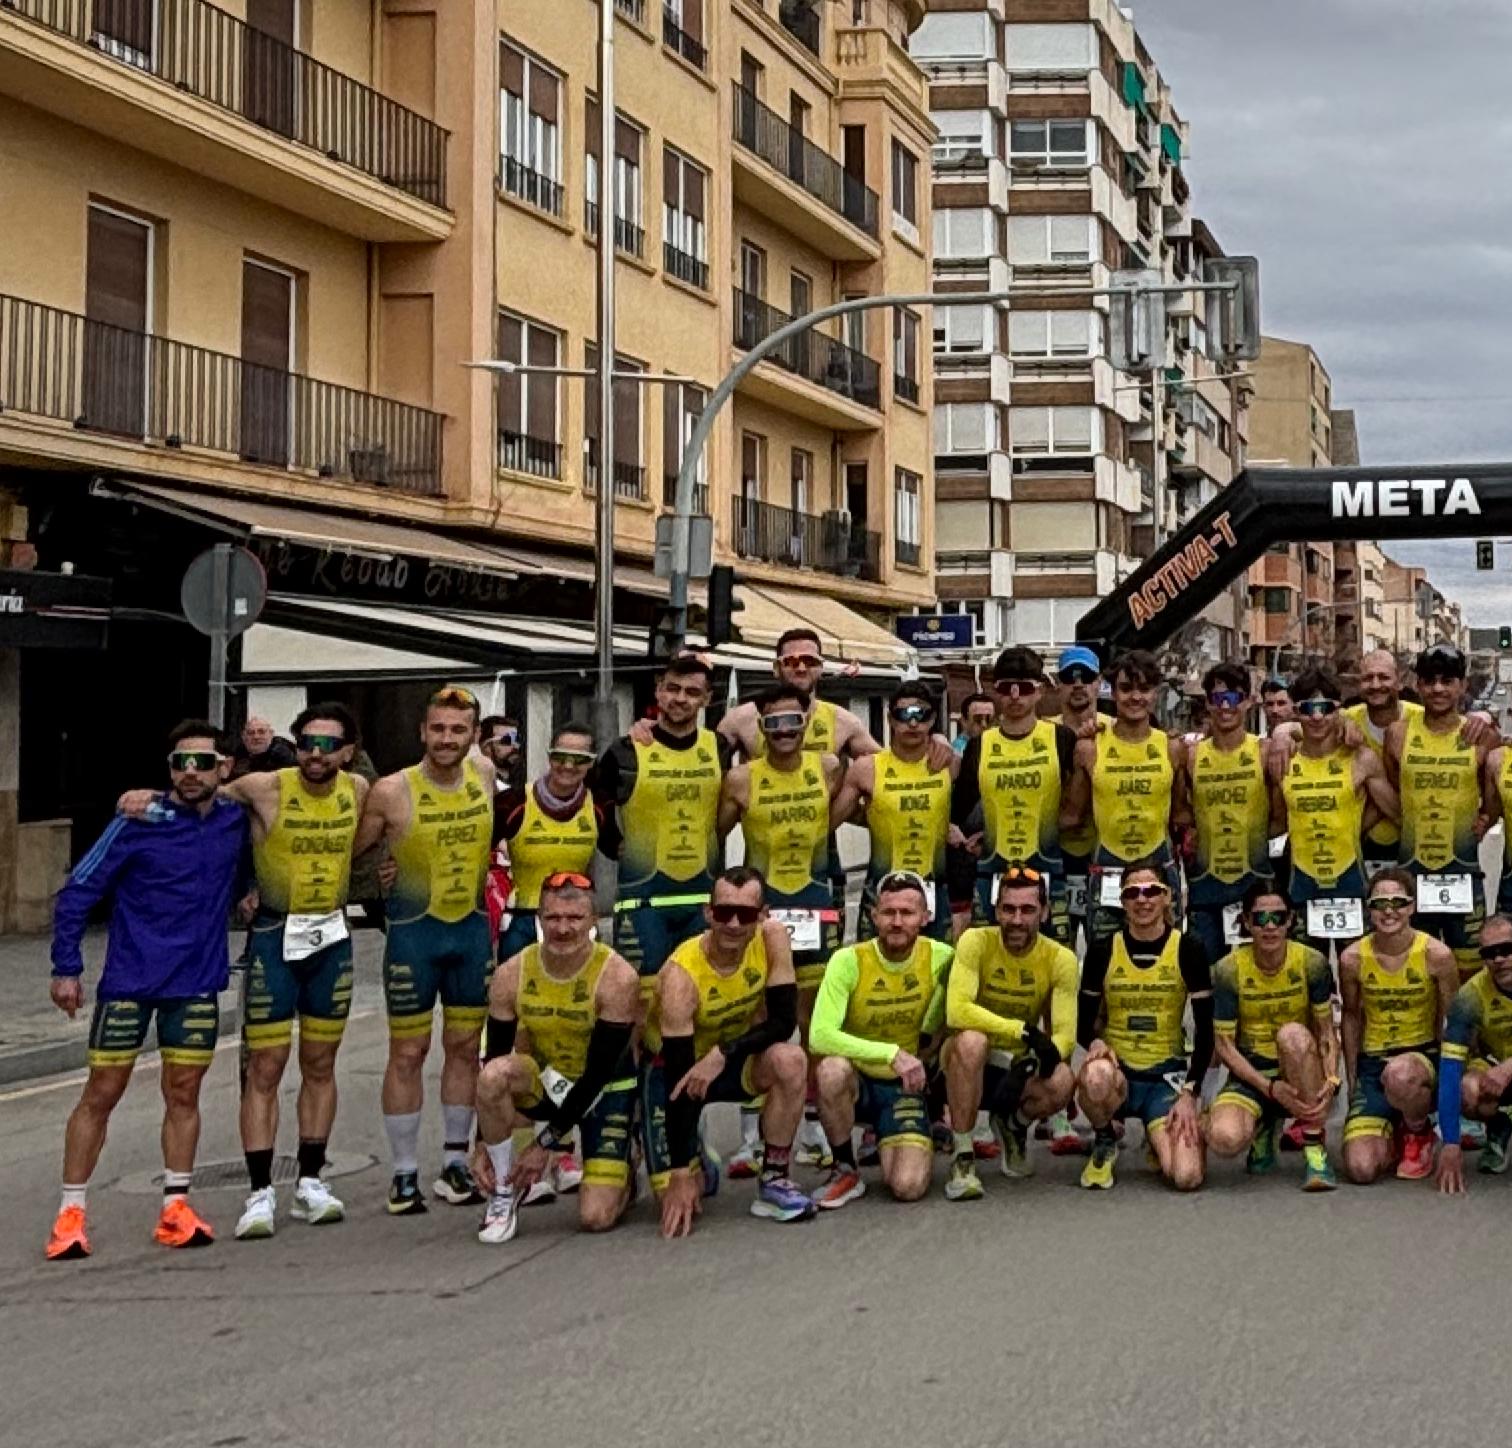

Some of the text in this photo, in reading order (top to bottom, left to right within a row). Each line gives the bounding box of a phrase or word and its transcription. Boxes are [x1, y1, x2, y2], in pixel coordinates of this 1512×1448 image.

[1331, 478, 1482, 518] META
[1127, 511, 1238, 630] ACTIVA-T
[1322, 911, 1347, 930] 63
[308, 930, 323, 947] 3
